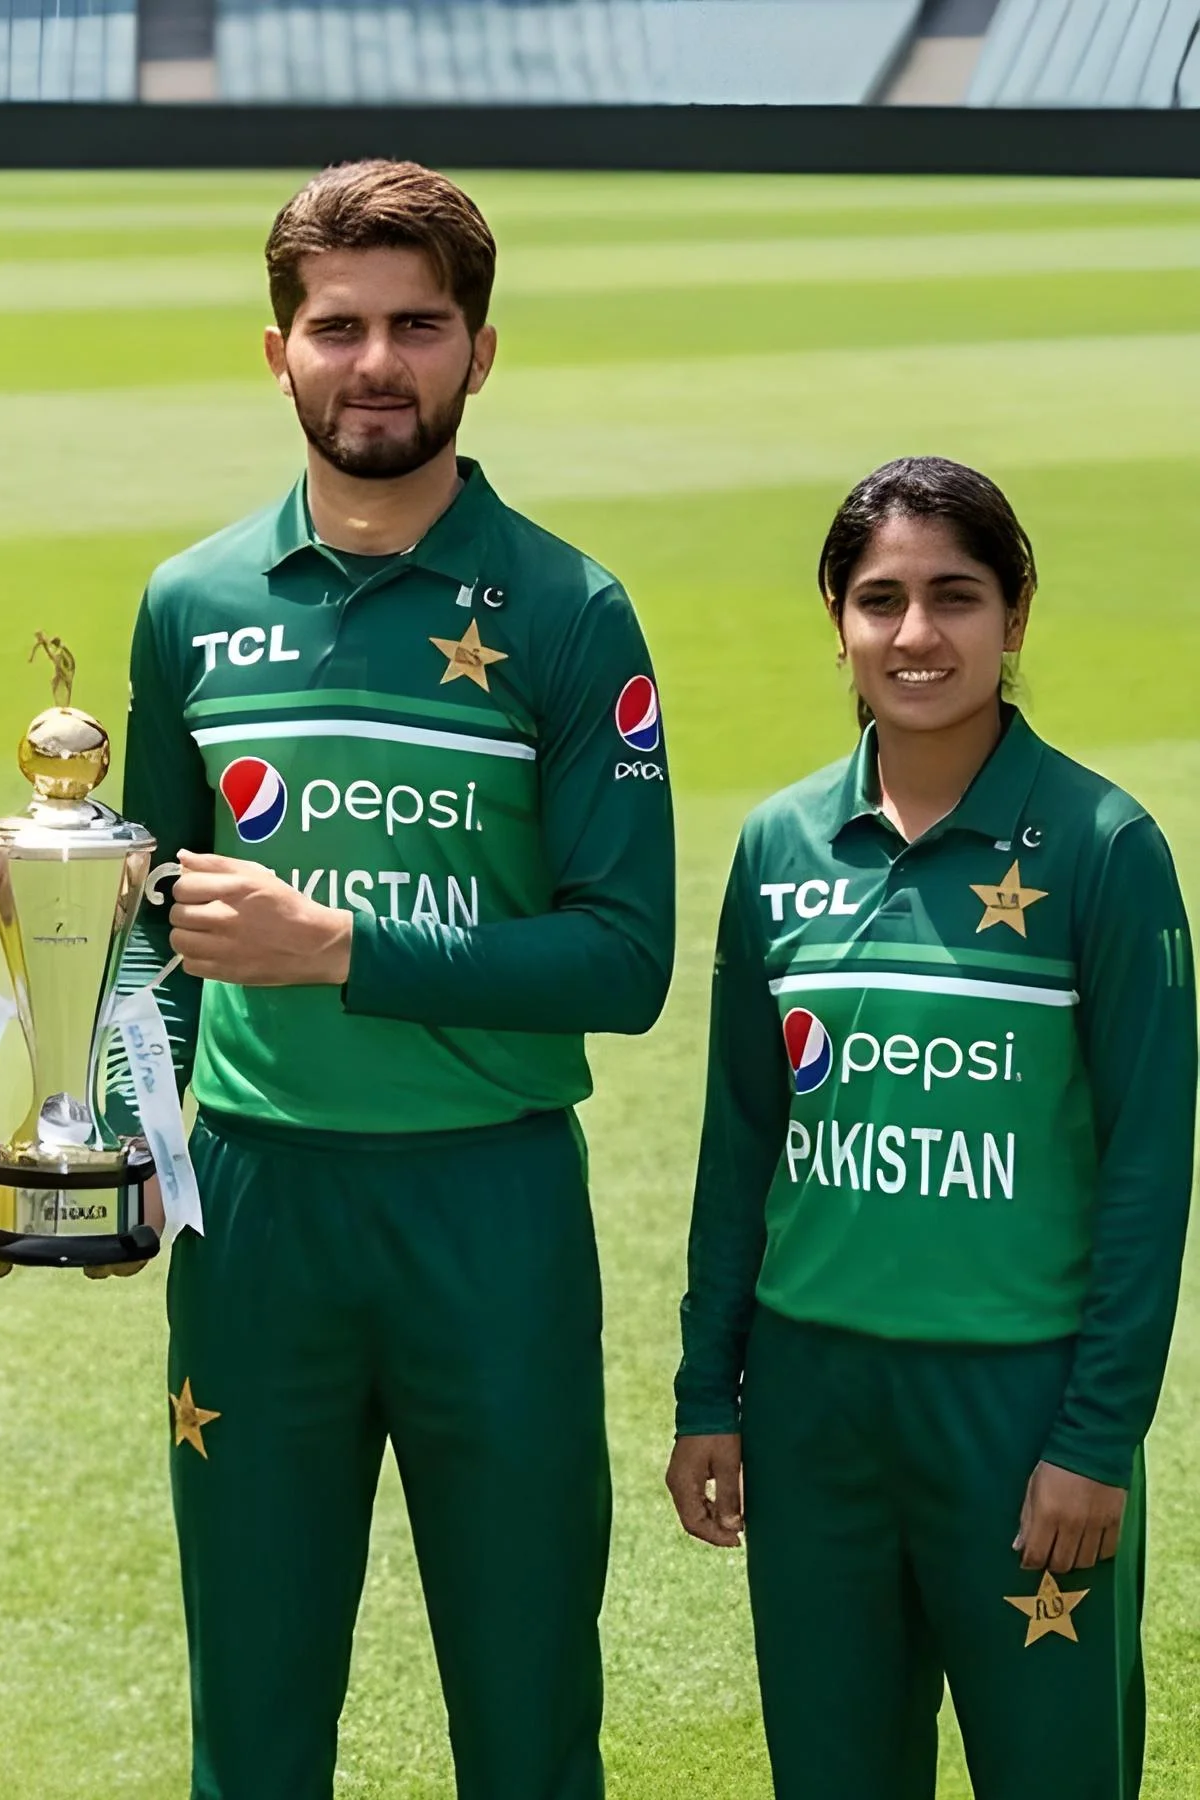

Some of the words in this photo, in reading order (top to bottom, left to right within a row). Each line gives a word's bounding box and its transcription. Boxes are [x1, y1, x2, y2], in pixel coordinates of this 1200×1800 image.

[192, 624, 300, 673] TCL
[301, 779, 476, 836] pepsi
[272, 868, 479, 930] KISTAN
[760, 878, 860, 921] TCL
[841, 1031, 1015, 1091] pepsi
[786, 1119, 1015, 1199] PAKISTAN
